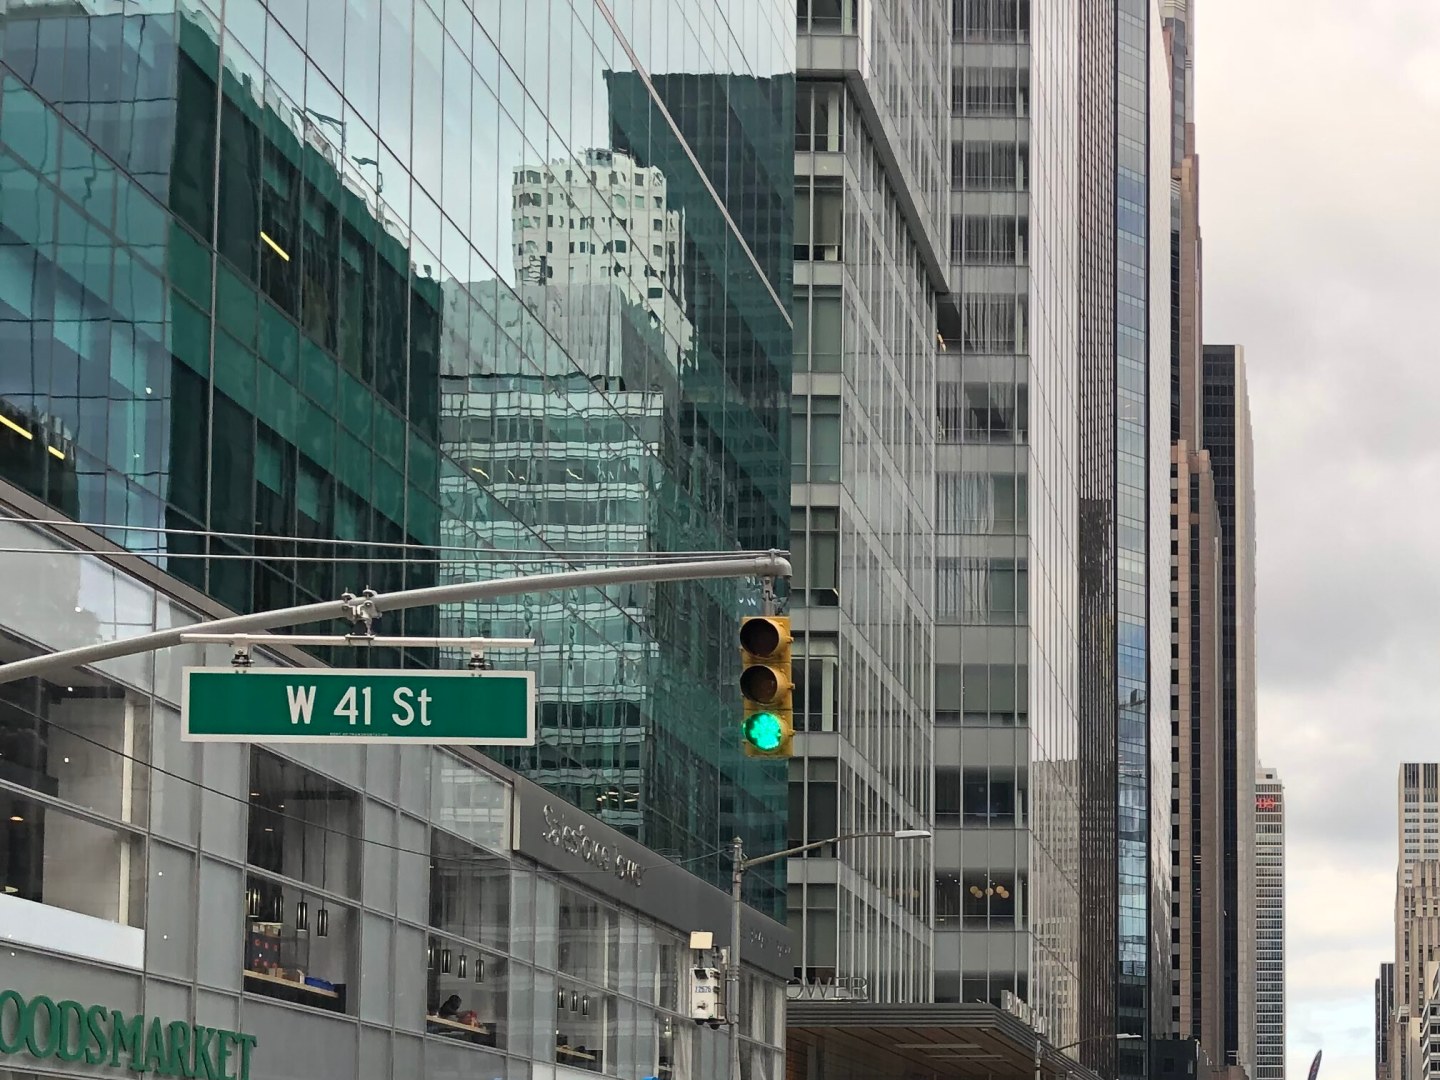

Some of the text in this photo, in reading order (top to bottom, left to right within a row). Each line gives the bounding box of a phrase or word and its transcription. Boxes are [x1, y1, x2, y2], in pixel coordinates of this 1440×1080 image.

[286, 685, 432, 726] W 41 St
